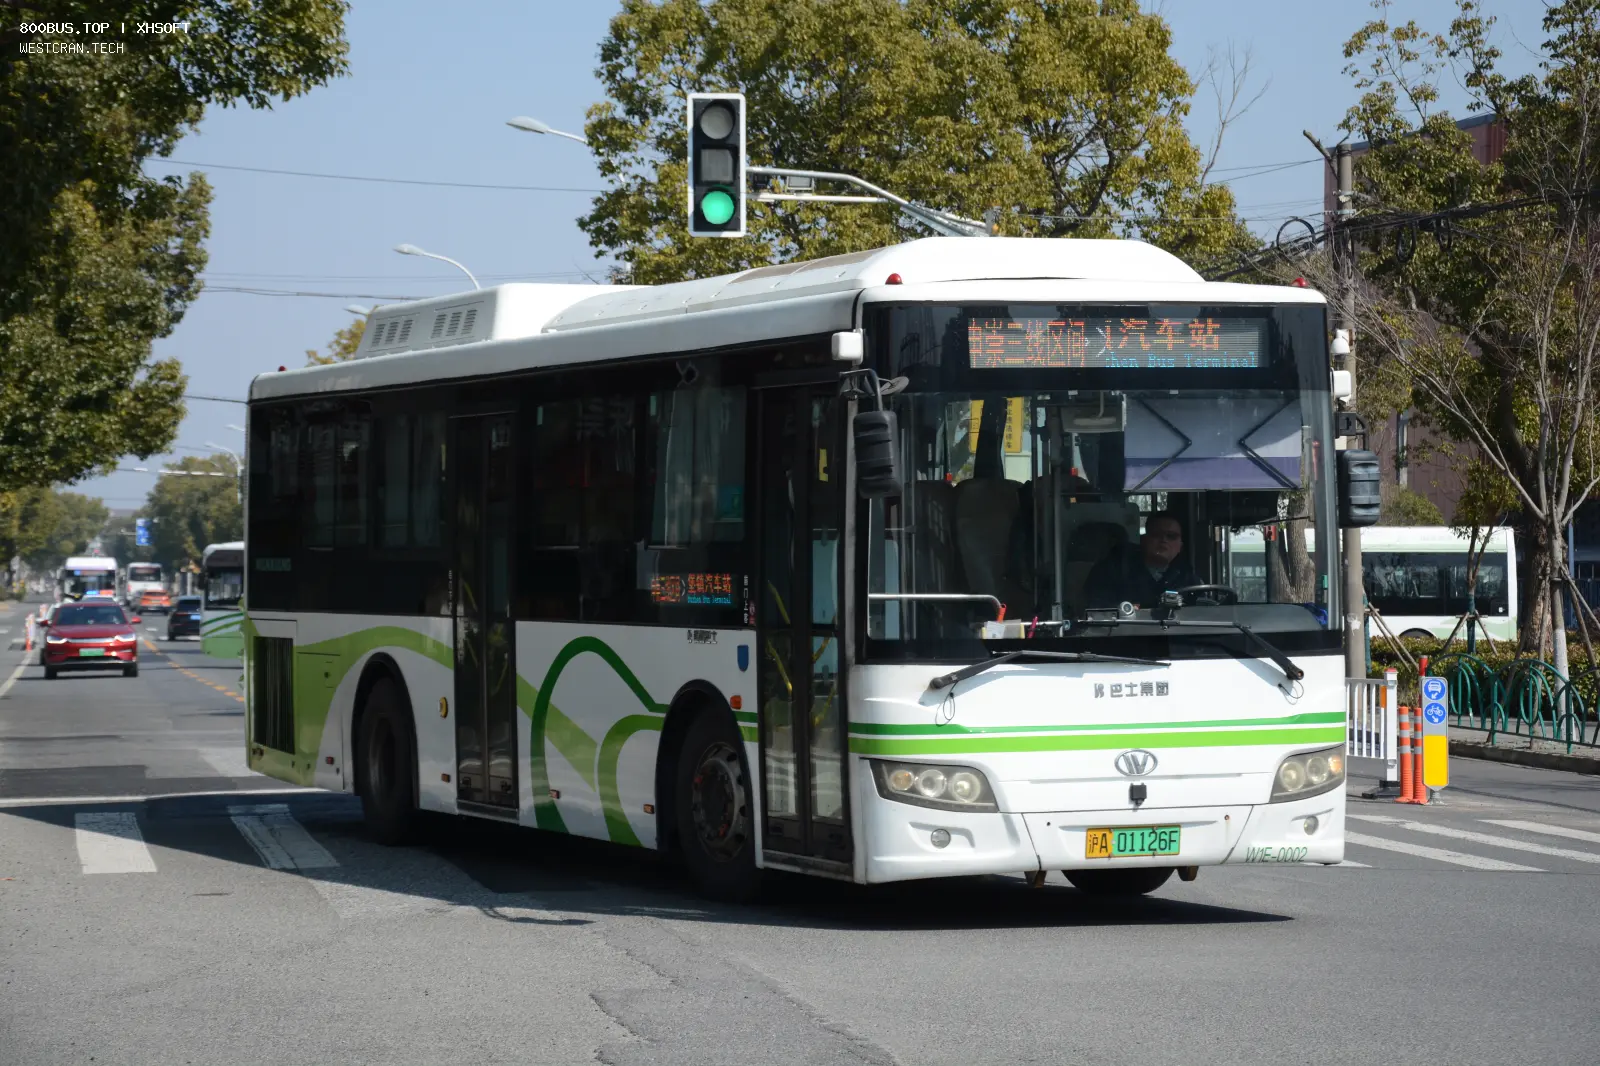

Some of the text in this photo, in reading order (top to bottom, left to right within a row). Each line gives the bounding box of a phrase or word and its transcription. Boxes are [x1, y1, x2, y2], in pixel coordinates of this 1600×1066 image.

[1148, 353, 1175, 368] Bus
[1185, 352, 1258, 368] Terminal
[1088, 830, 1179, 854] 沪A 01126F
